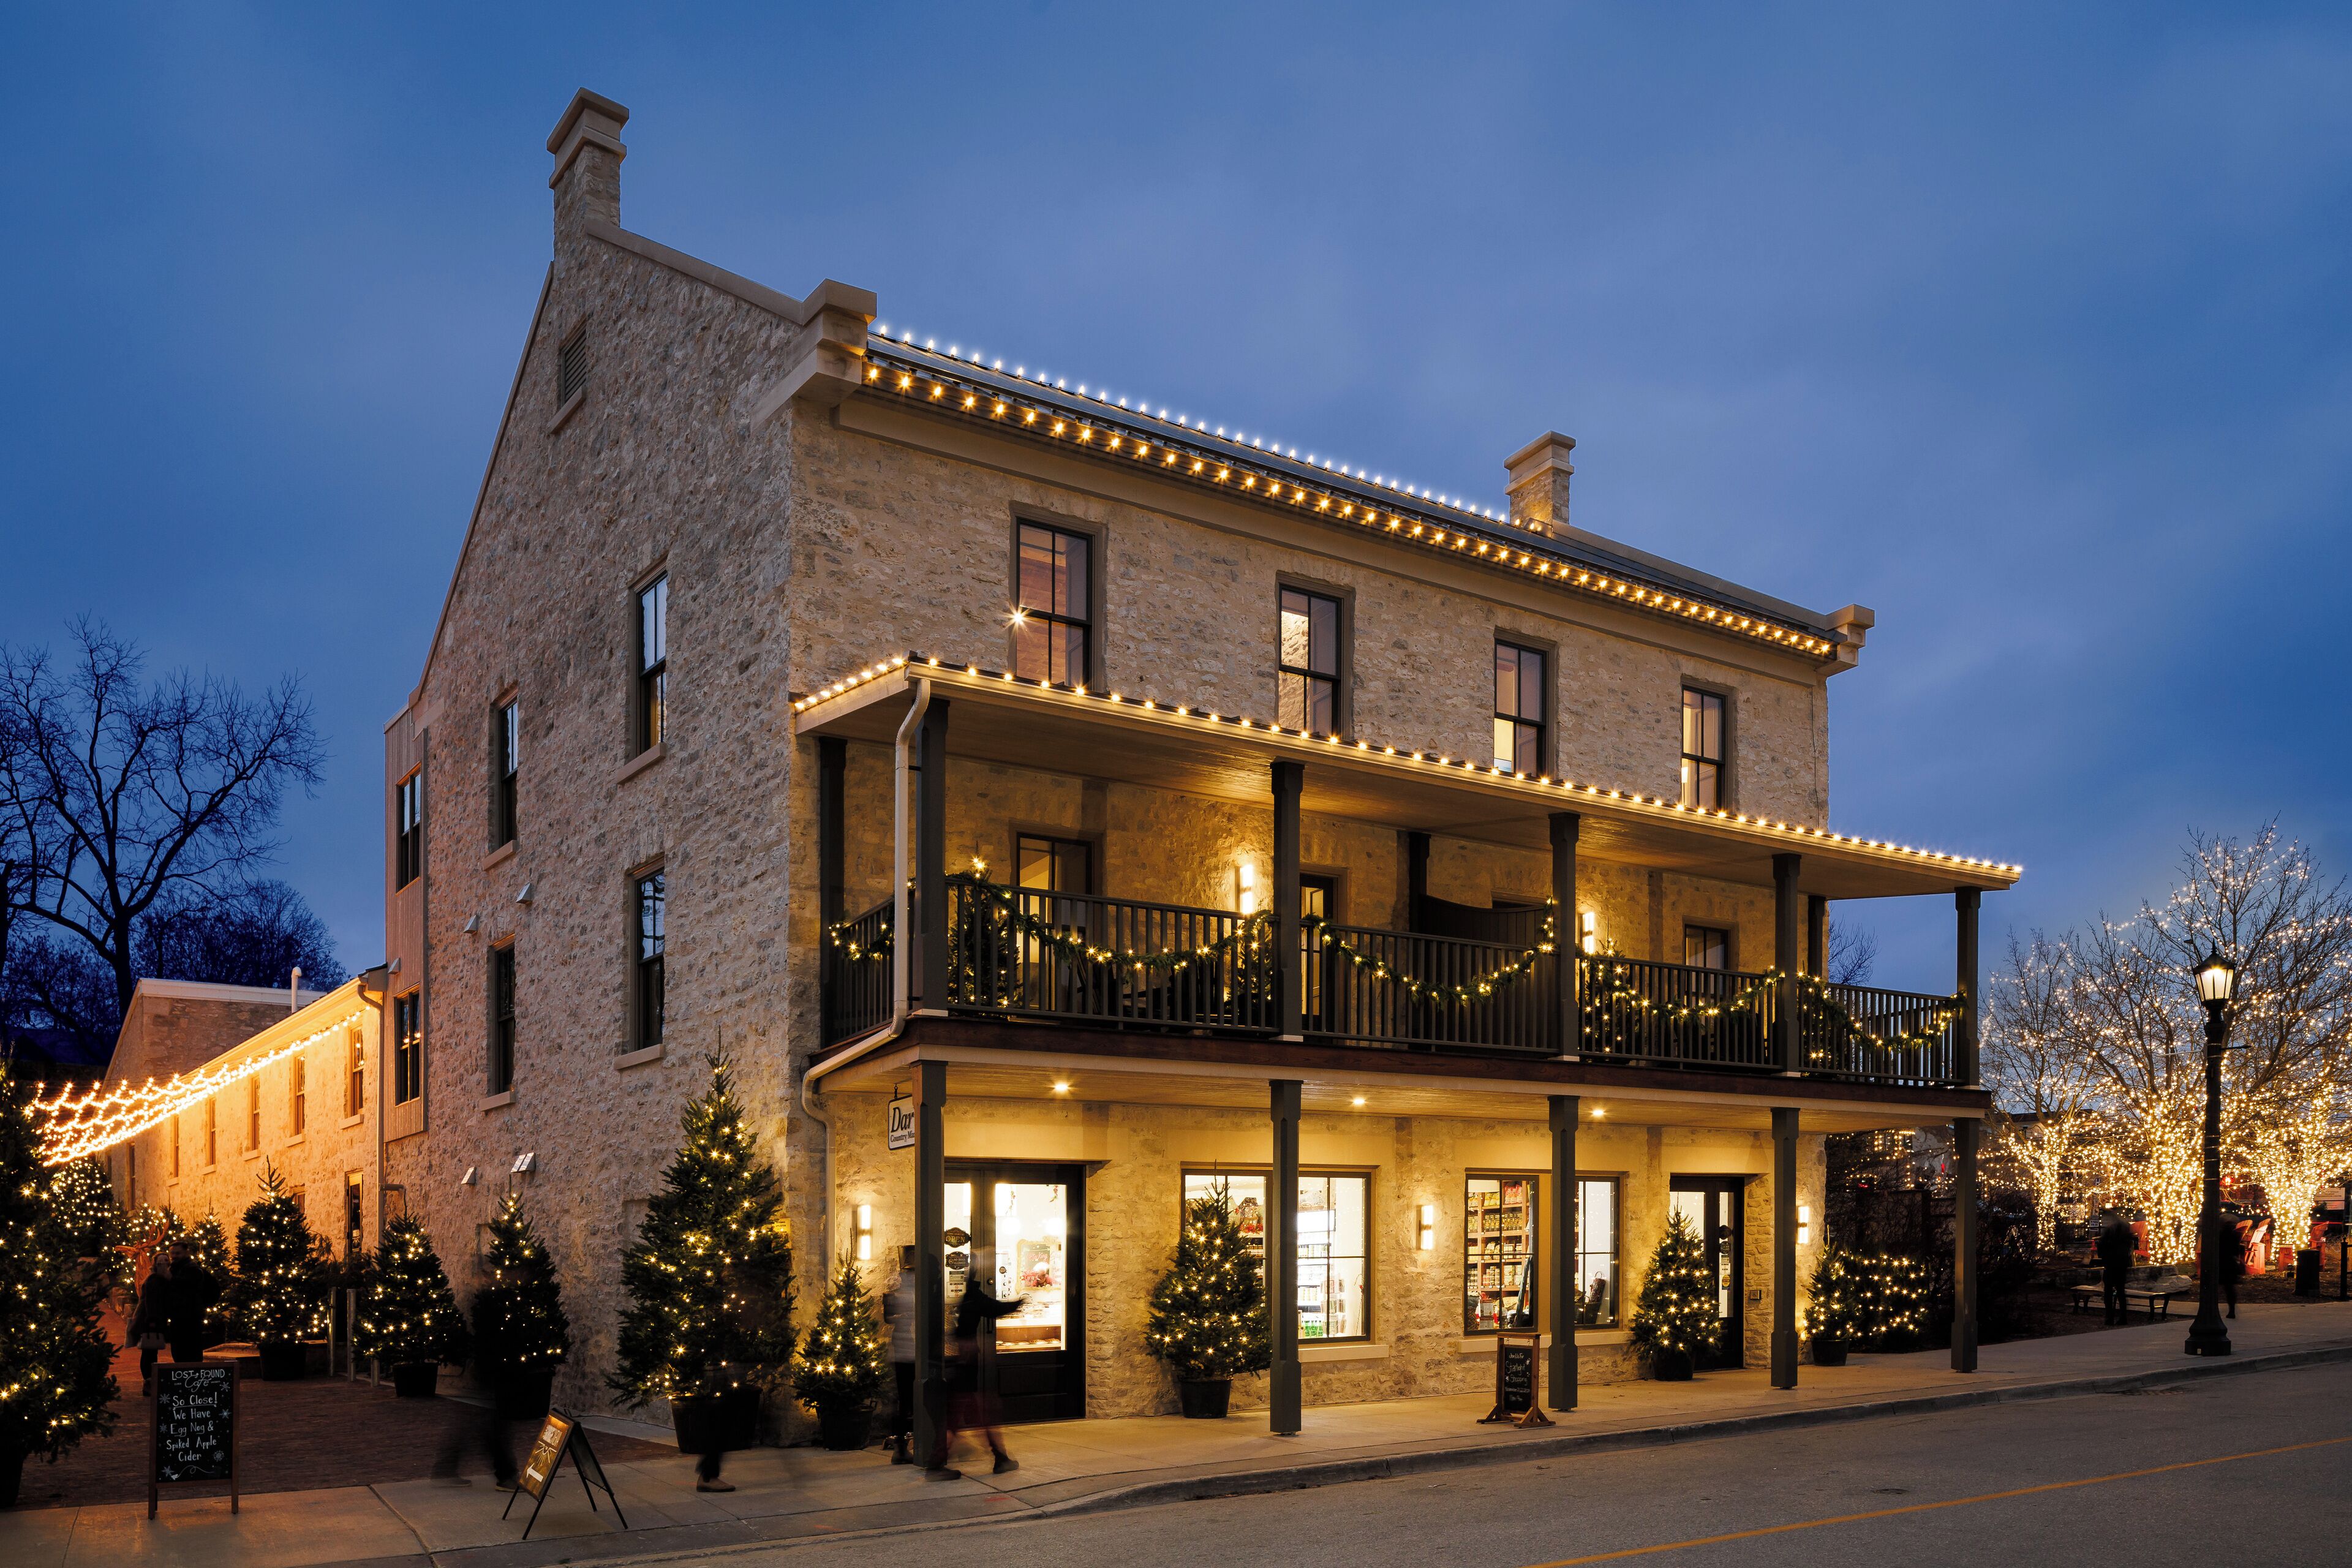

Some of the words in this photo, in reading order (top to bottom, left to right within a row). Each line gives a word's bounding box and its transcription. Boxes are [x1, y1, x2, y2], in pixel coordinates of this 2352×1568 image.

[172, 1370, 194, 1380] LOST
[200, 1369, 225, 1378] FOUND
[173, 1396, 184, 1406] So
[190, 1392, 217, 1405] Close!
[173, 1409, 186, 1420] We
[190, 1408, 211, 1419] Have
[171, 1423, 187, 1437] Egg
[190, 1422, 205, 1434] Nog
[207, 1420, 214, 1431] &
[166, 1438, 189, 1451] Spiked
[196, 1434, 217, 1449] Apple
[178, 1450, 202, 1461] Cider
